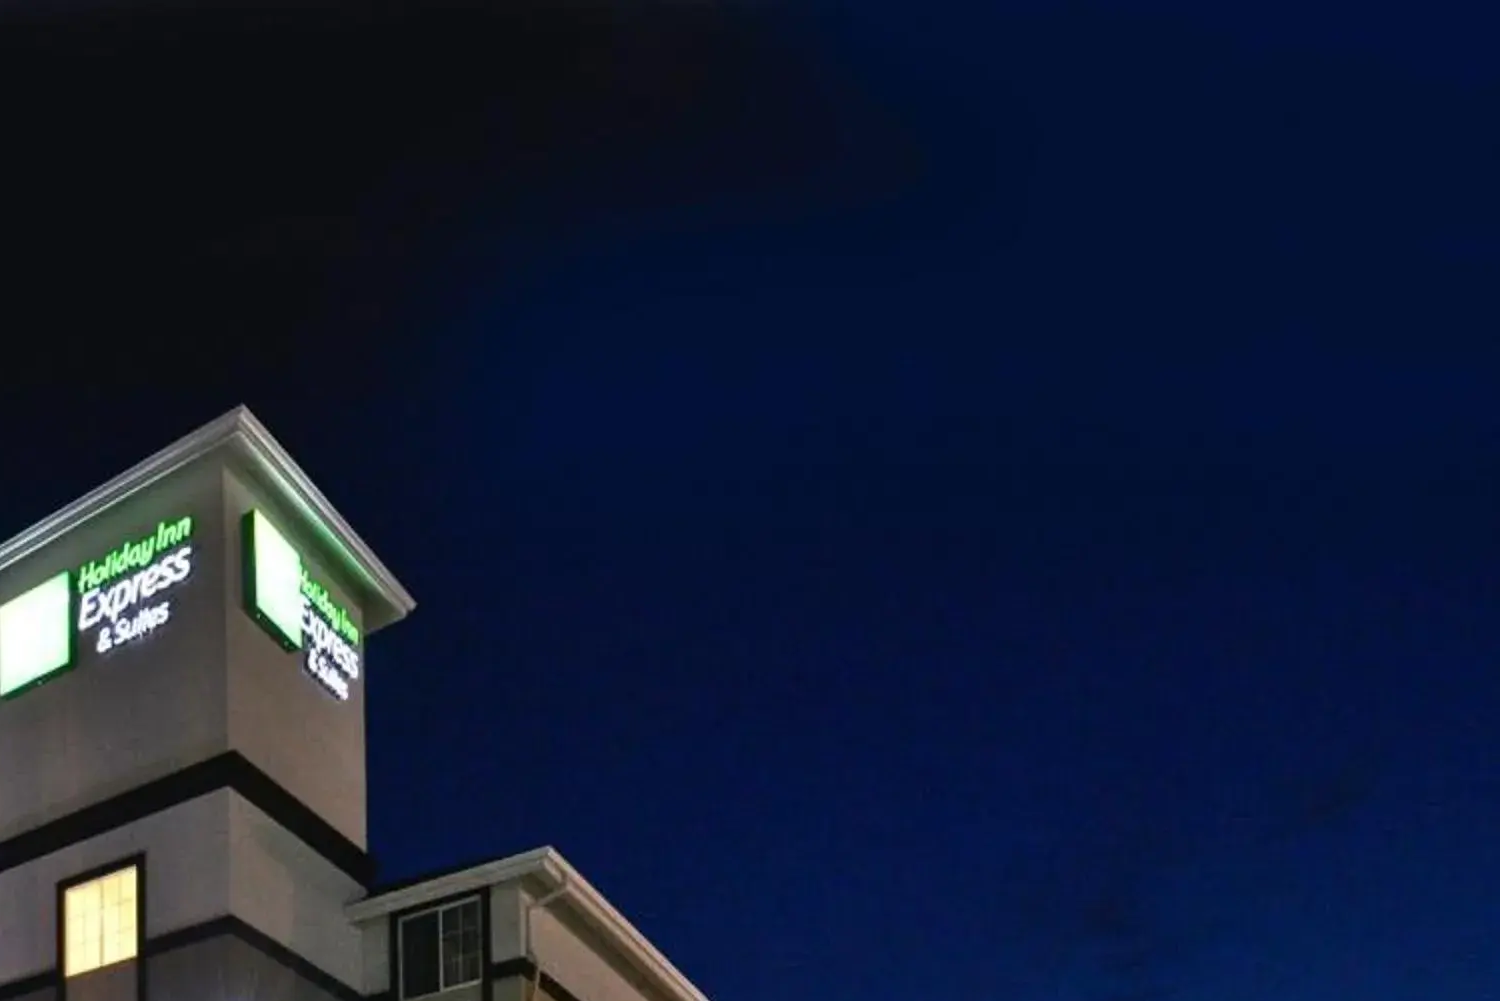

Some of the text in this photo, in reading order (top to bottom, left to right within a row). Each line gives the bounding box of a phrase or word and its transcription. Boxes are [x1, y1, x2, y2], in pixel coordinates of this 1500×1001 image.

[77, 546, 192, 632] Express
[78, 516, 192, 594] Holiday Inn
[95, 601, 170, 654] & Suites
